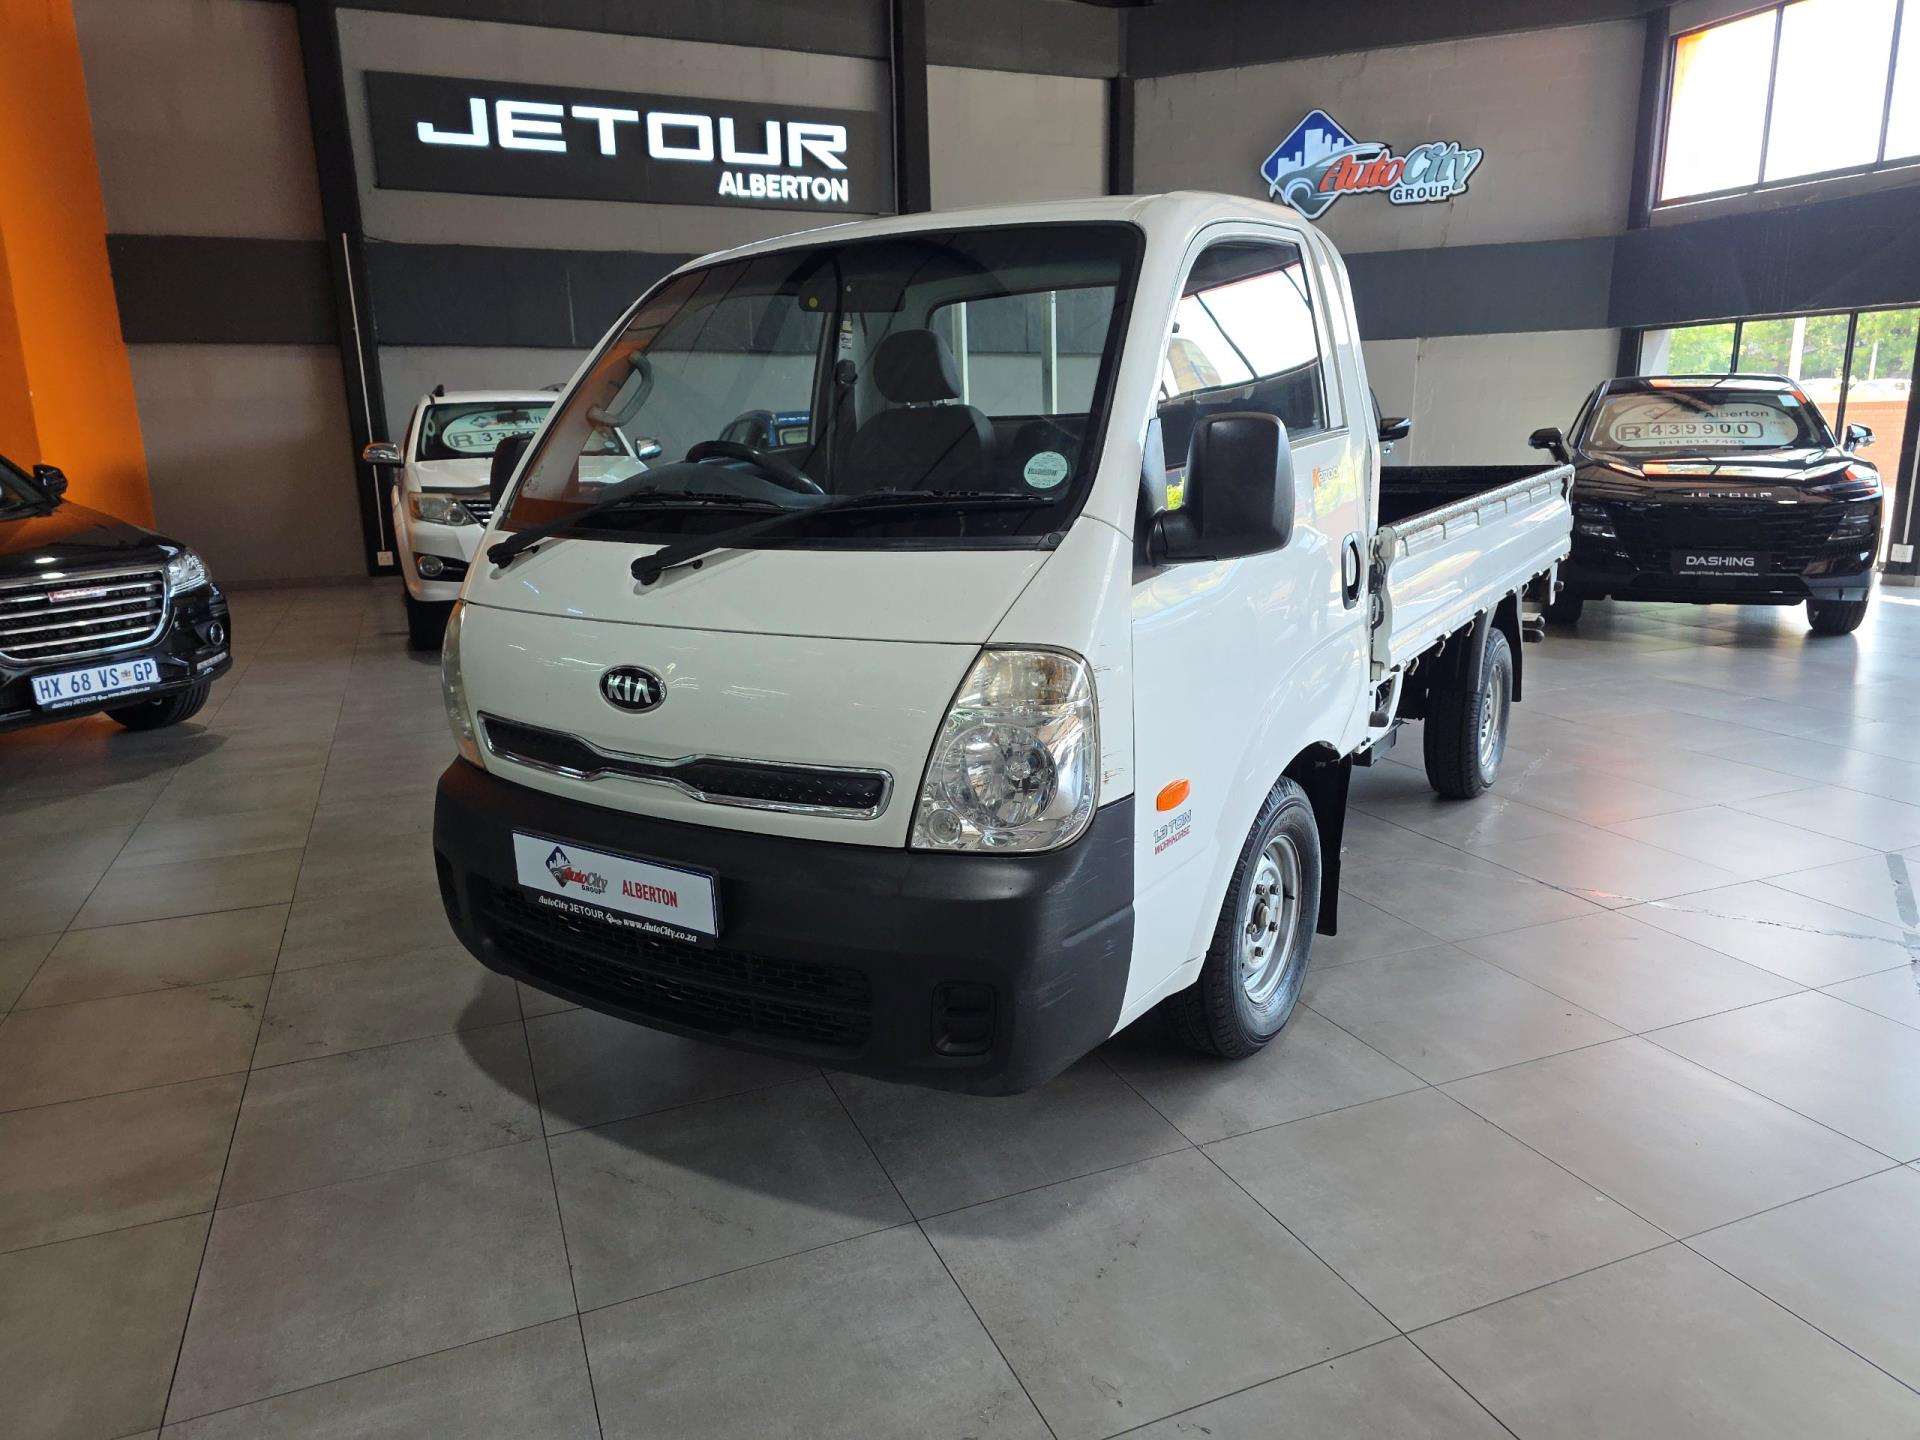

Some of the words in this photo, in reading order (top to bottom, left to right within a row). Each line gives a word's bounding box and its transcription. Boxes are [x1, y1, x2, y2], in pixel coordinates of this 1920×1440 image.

[417, 97, 848, 169] JETOUR
[1319, 144, 1480, 192] AutoCity
[718, 171, 849, 201] ALBERTON
[1393, 185, 1449, 201] GROUP
[1704, 409, 1769, 418] Alberton
[1650, 424, 1749, 435] 439900
[1686, 556, 1755, 567] DASHING
[39, 677, 62, 699] HX
[71, 673, 92, 693] 68
[98, 668, 119, 688] VS
[133, 661, 153, 681] GP
[608, 675, 652, 703] KIA
[622, 880, 678, 908] ALBERTON
[538, 896, 568, 911] AutoCity
[569, 903, 604, 920] JETOUR
[623, 919, 698, 943] www.AutoCity.co.za
